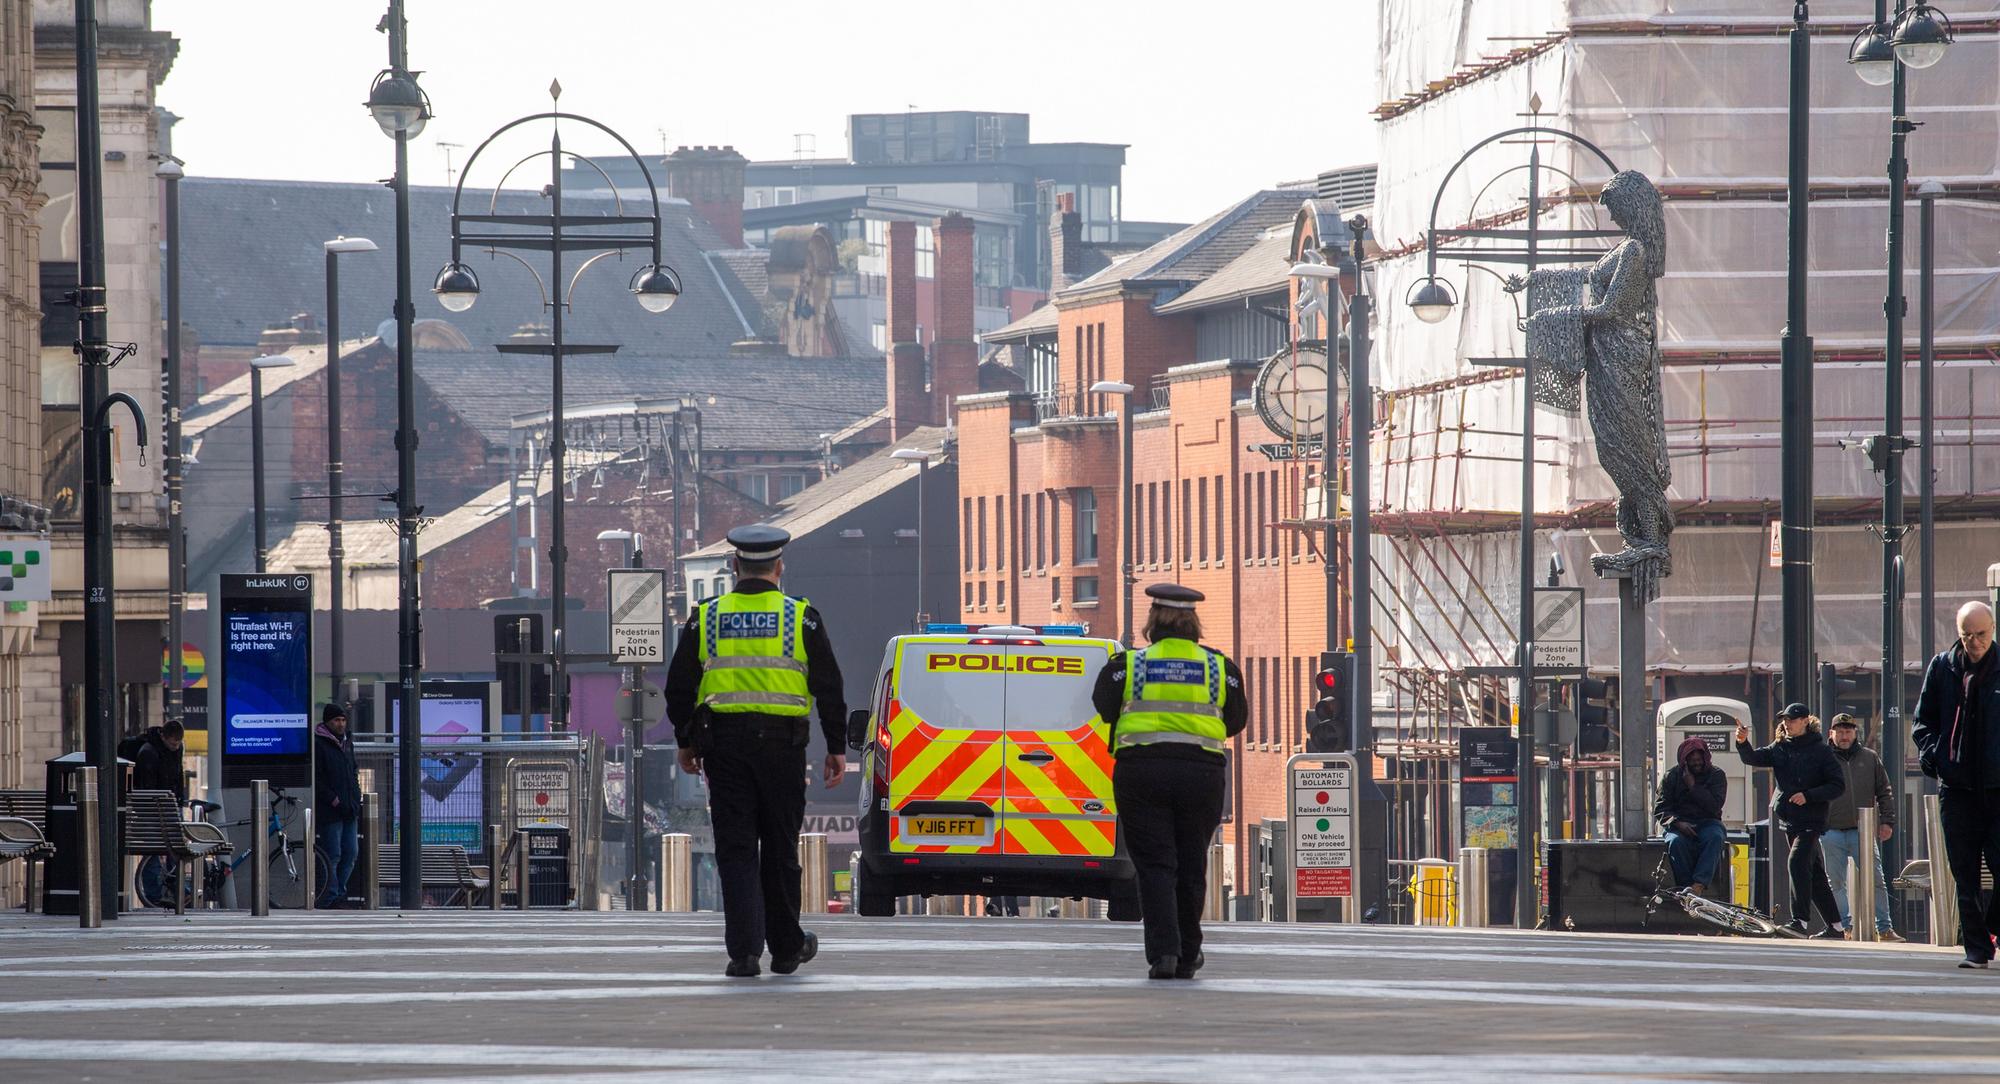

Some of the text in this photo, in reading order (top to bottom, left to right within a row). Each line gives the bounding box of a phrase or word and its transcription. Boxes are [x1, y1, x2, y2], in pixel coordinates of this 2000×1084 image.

[246, 578, 287, 588] InLinkUK
[91, 587, 105, 597] 37
[721, 613, 777, 629] POLICE
[230, 622, 293, 631] Ultrafast Wi-Fi
[240, 632, 259, 640] free
[260, 632, 277, 640] and
[279, 632, 292, 640] it's
[615, 628, 660, 636] Pedestrian
[627, 637, 648, 645] Zone
[230, 641, 276, 652] right here.
[618, 646, 657, 656] ENDS
[1534, 645, 1579, 653] Pedestrian
[1545, 654, 1566, 662] Zone
[929, 654, 1083, 674] POLICE
[1696, 712, 1722, 724] free
[1326, 806, 1348, 814] Rising
[917, 821, 976, 833] YJ16 FFT
[534, 848, 552, 856] Litter
